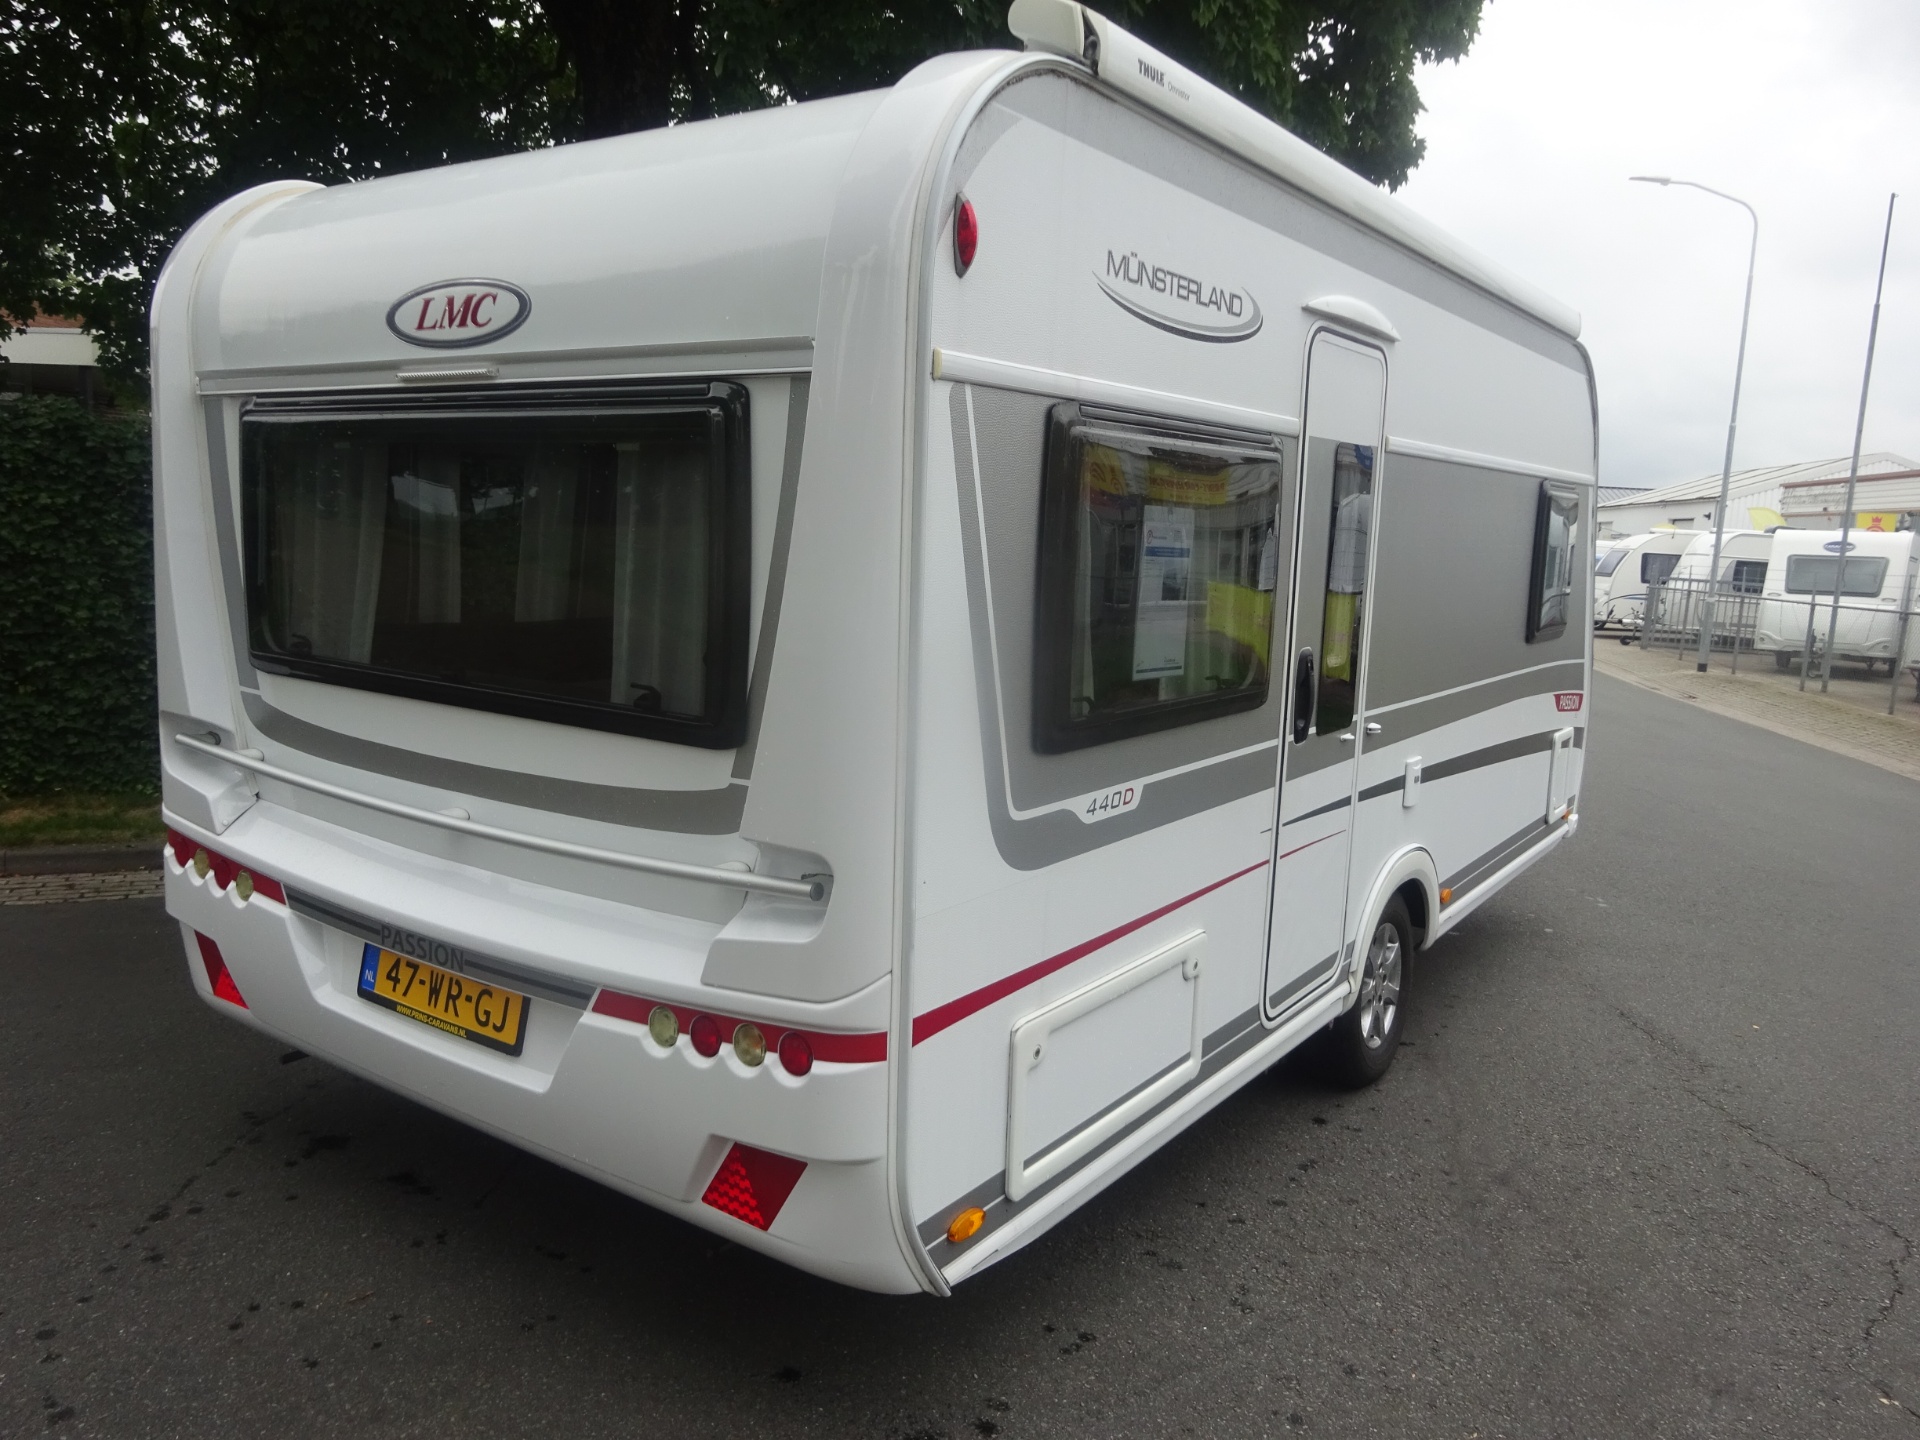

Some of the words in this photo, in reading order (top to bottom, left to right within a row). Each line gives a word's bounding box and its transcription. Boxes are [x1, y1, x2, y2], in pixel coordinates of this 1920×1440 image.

[1137, 58, 1165, 88] THULE
[1106, 249, 1243, 318] MÜNSTERLAND
[414, 292, 498, 331] LMC
[1086, 787, 1134, 816] 440D
[379, 924, 464, 973] PASSION
[364, 968, 375, 983] NL
[385, 957, 511, 1034] 47-WR-GJ
[396, 1004, 467, 1038] WWW.PRINS-CARAVANS.NL
